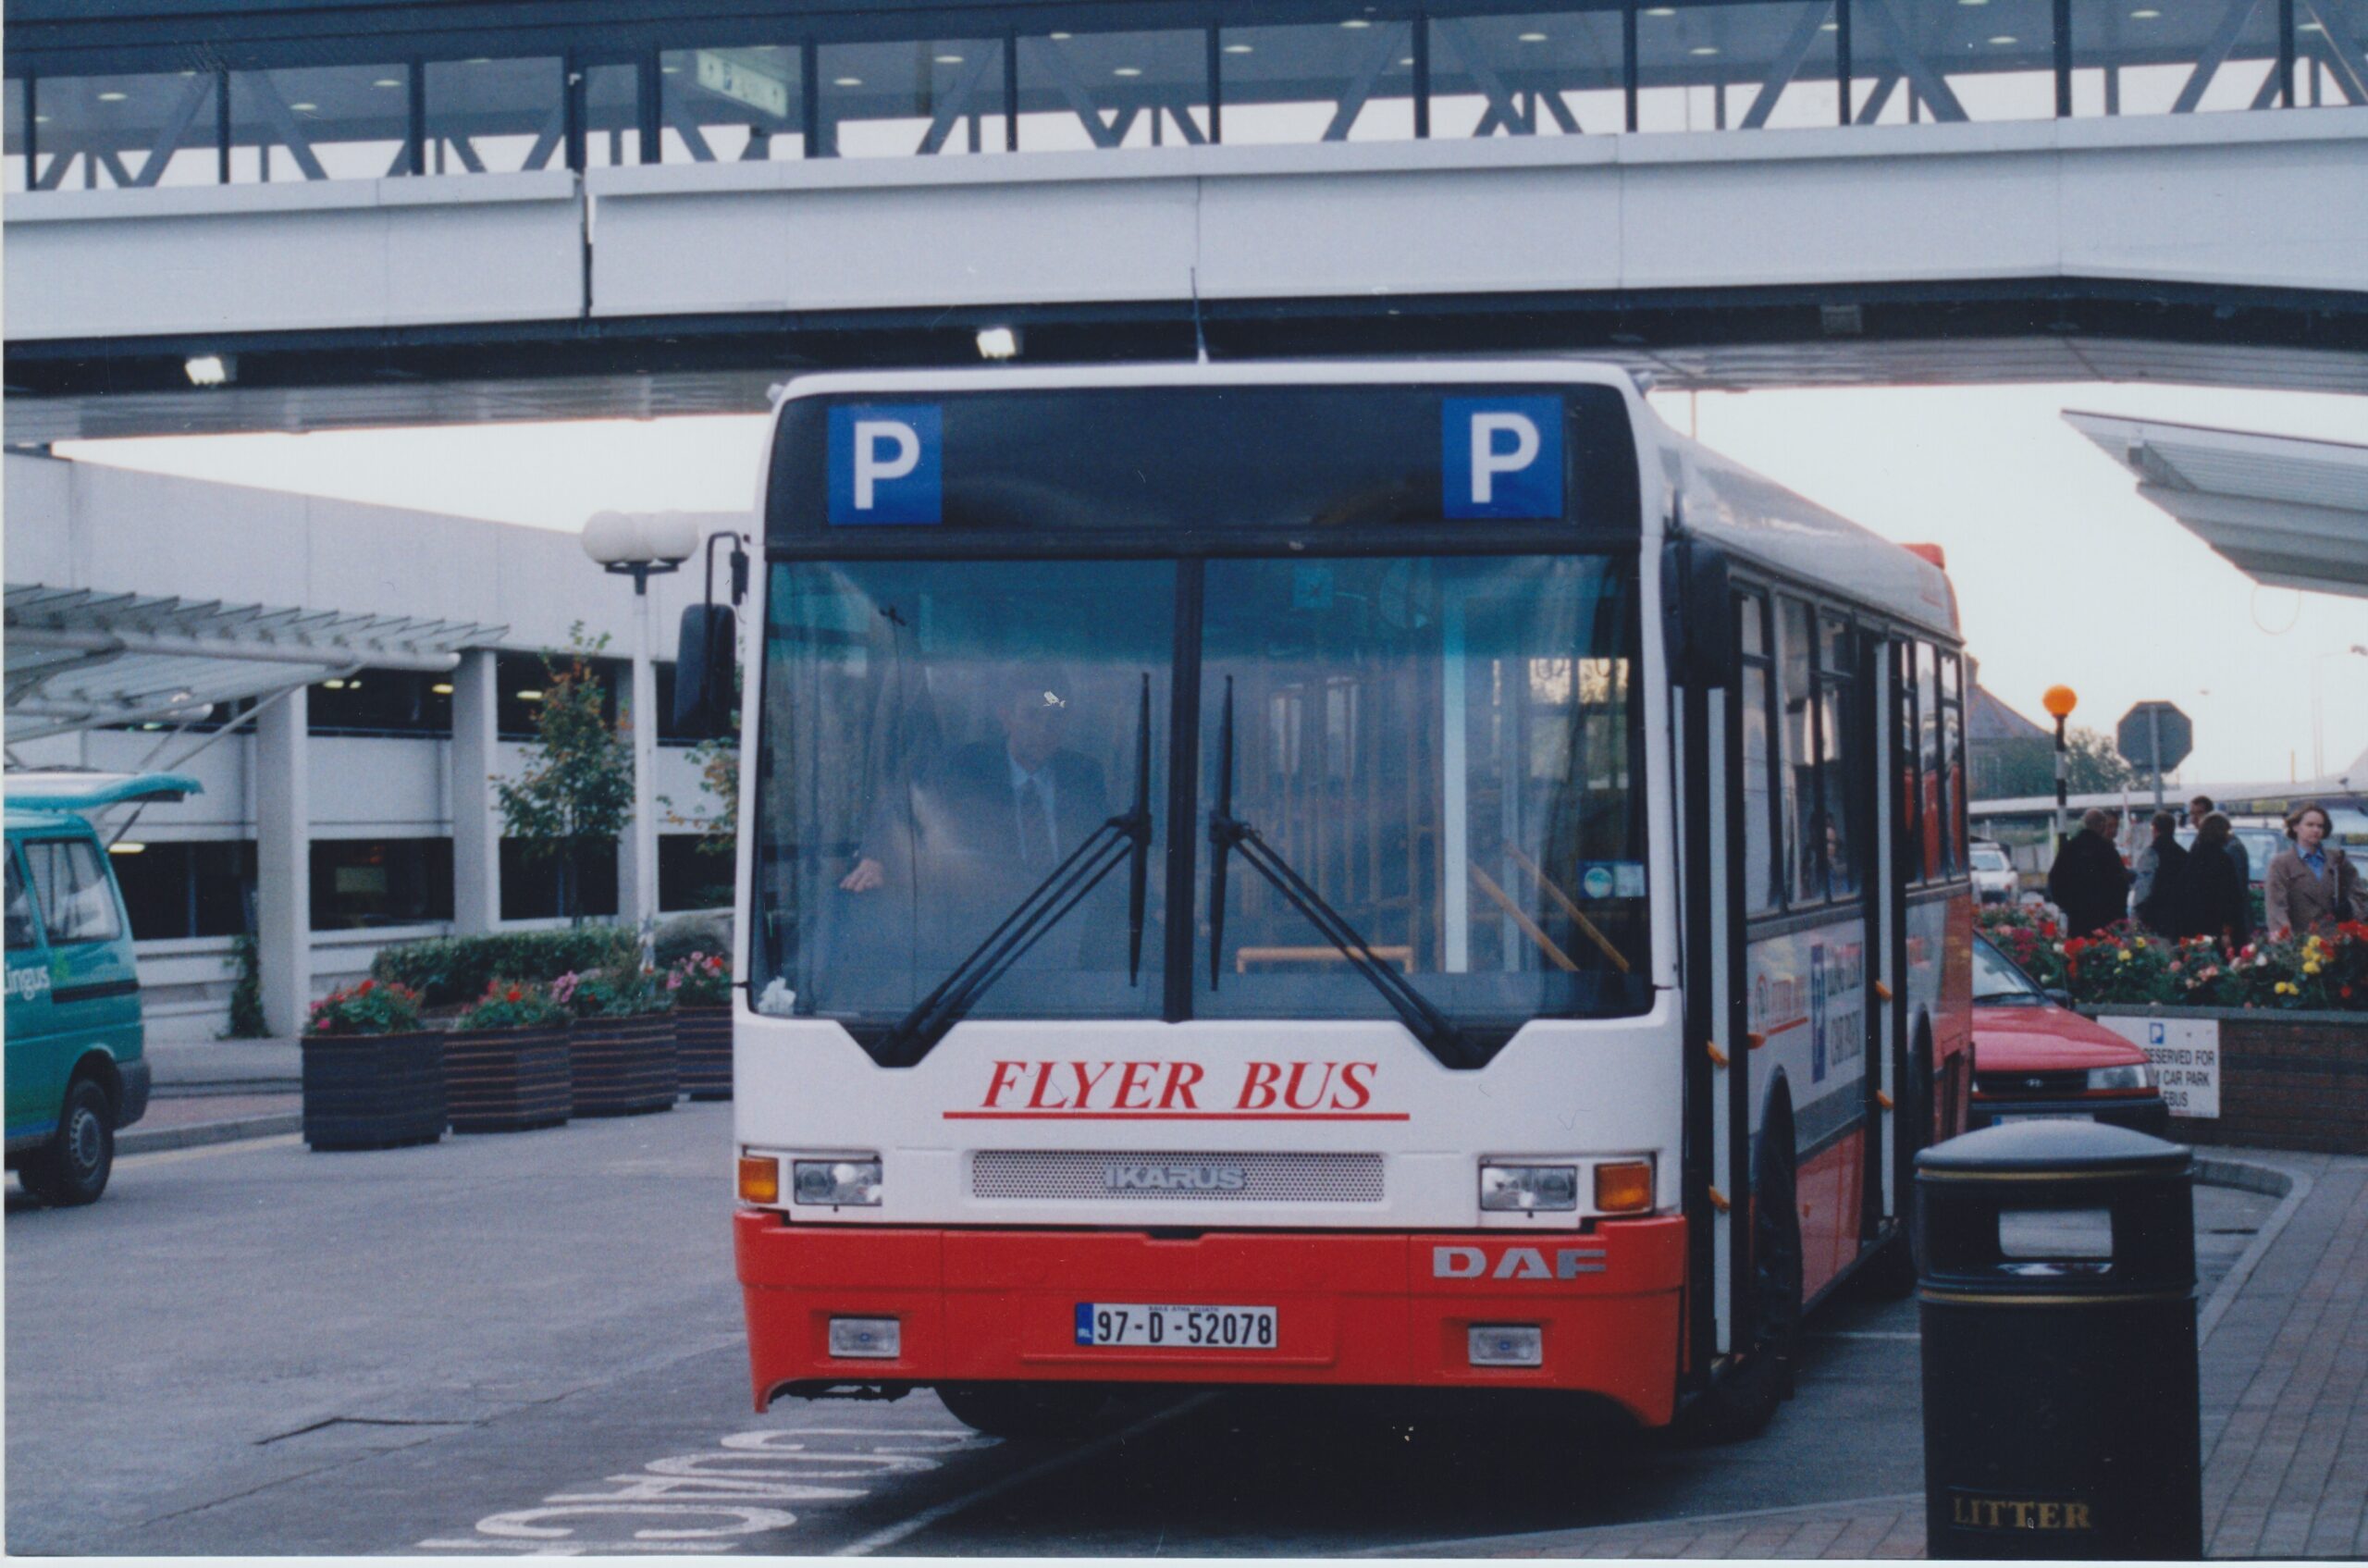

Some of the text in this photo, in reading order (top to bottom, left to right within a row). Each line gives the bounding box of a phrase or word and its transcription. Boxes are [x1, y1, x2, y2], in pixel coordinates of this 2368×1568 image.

[855, 421, 919, 509] P
[1472, 413, 1539, 502] P
[5, 963, 51, 1001] ingus
[2195, 1050, 2214, 1065] FOR
[980, 1061, 1378, 1110] FLYER BUS
[2164, 1070, 2183, 1086] CAR
[2186, 1071, 2211, 1087] PARK
[1105, 1167, 1244, 1189] IKARUS
[1434, 1246, 1606, 1278] DAF
[1097, 1311, 1273, 1345] 97-D-52078
[1954, 1497, 2091, 1528] LITTER
